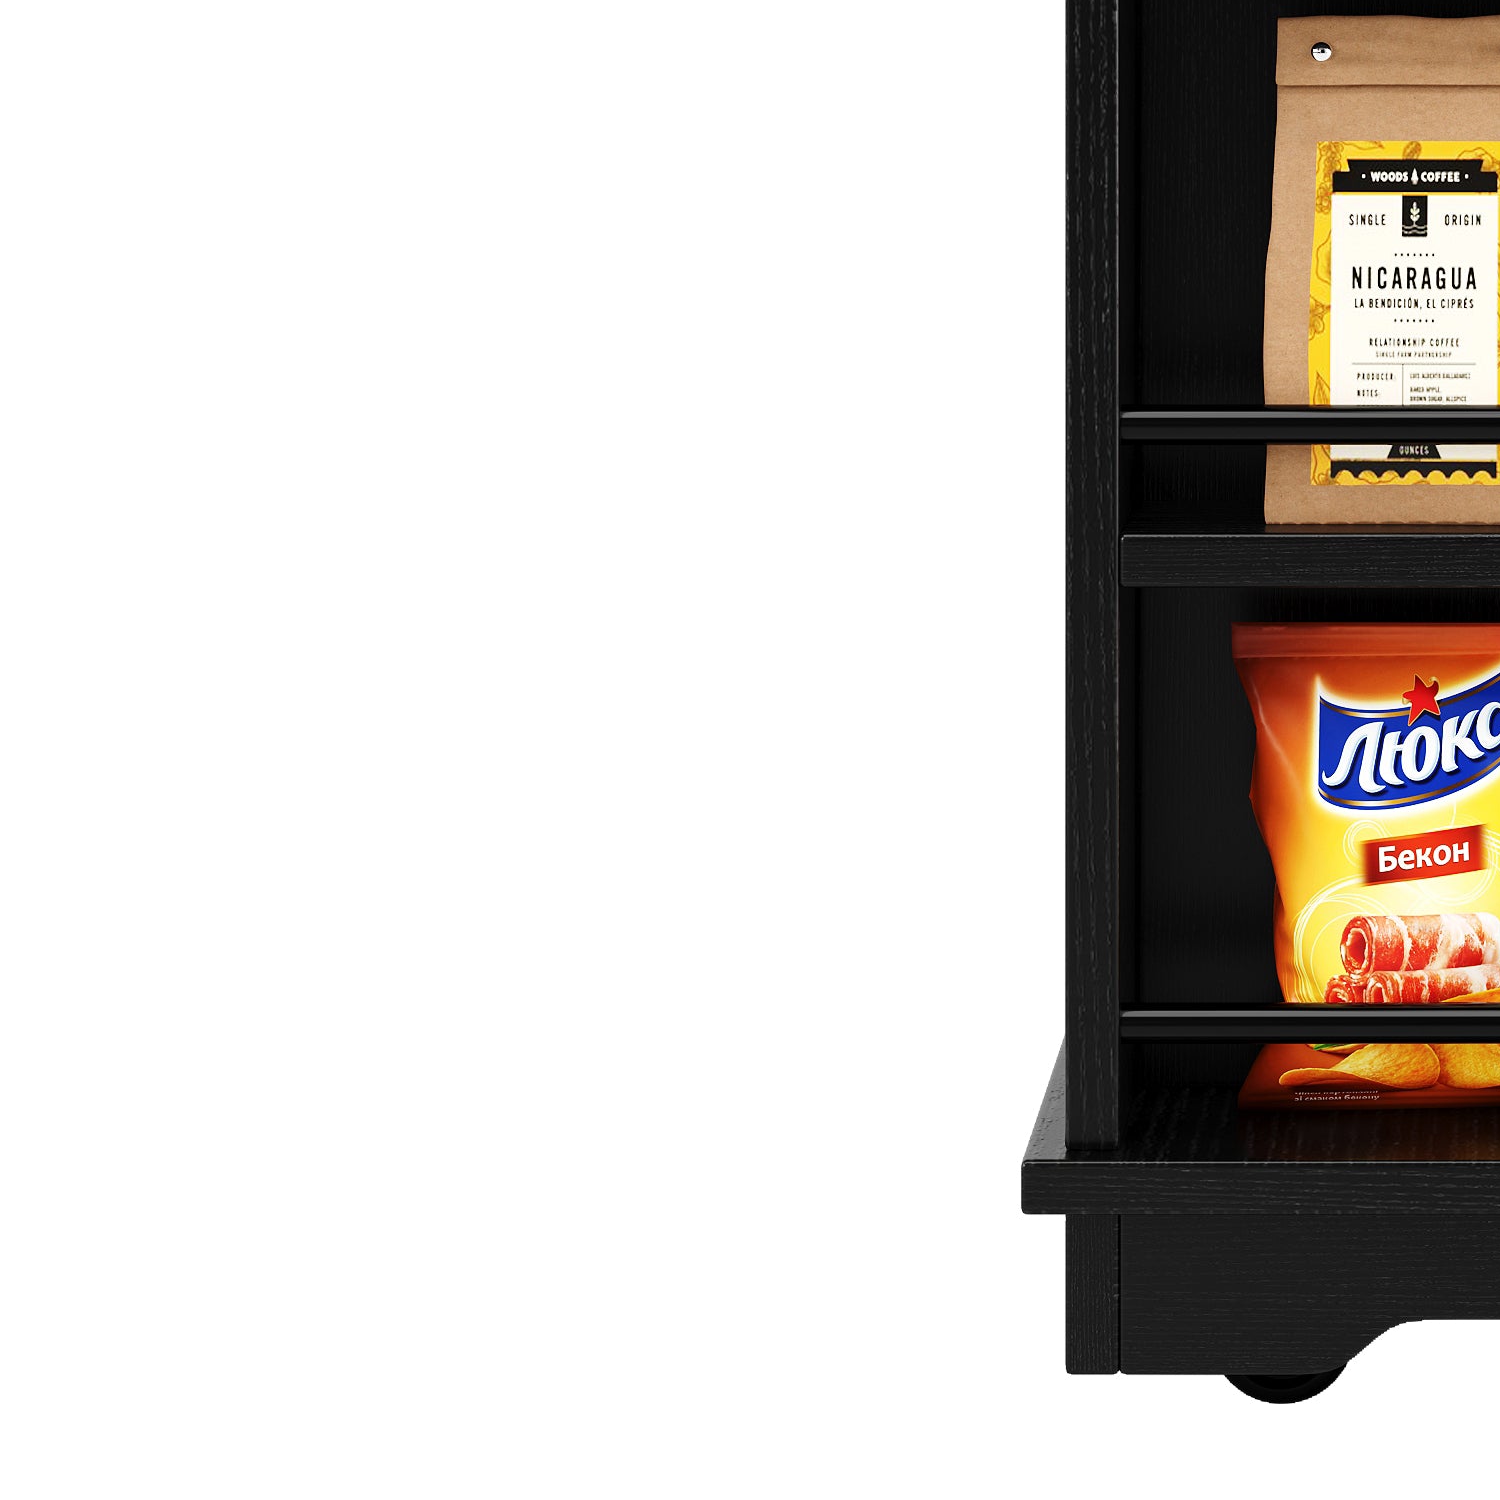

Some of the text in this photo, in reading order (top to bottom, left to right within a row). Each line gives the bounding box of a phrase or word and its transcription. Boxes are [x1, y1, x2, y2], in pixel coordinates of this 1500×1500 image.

[1370, 171, 1461, 183] WOODS COFFEE
[1349, 214, 1386, 226] SINGLE
[1444, 214, 1482, 226] ORIGIN
[1352, 266, 1477, 290] NICARAGUA
[1354, 298, 1365, 308] LA
[1426, 298, 1436, 308] EL
[1440, 297, 1474, 309] CIPRÉS
[1369, 337, 1460, 347] RELATIONSHIP COFFEE
[1399, 445, 1430, 455] OUNCES
[1378, 838, 1471, 874] Бекон
